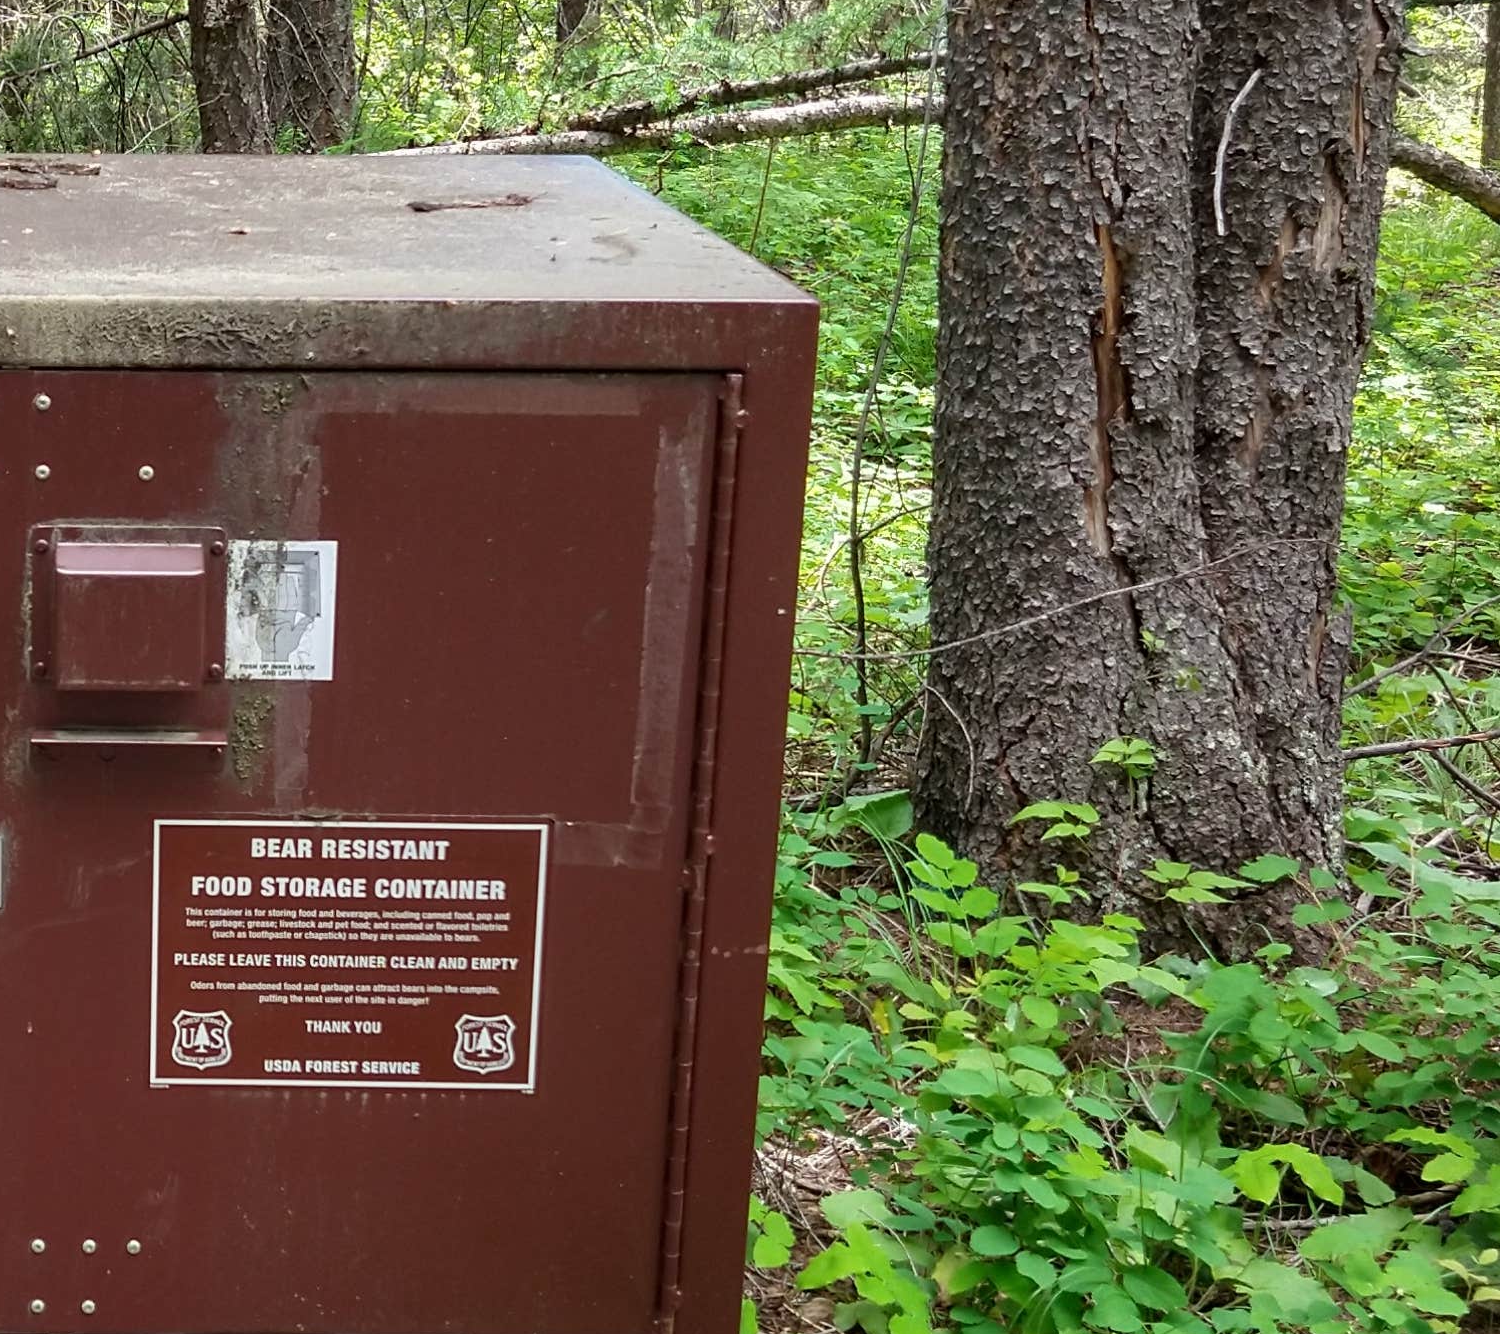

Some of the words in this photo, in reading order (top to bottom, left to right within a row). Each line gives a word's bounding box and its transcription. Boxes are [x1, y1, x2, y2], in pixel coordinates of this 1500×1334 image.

[251, 838, 312, 858] BEAR
[321, 840, 450, 860] RESISTANT
[192, 876, 252, 896] FOOD
[261, 877, 367, 898] STORAGE
[375, 879, 506, 900] CONTAINER
[186, 907, 201, 916] This
[204, 908, 241, 917] container
[245, 908, 251, 917] is
[253, 908, 265, 917] for
[268, 909, 296, 920] storing
[299, 909, 316, 918] food
[319, 909, 334, 918] and
[336, 910, 380, 920] beverages,
[382, 910, 421, 921] including
[422, 911, 452, 920] canned
[454, 911, 474, 921] food,
[477, 913, 492, 922] pop
[494, 912, 510, 921] and
[186, 918, 206, 928] beer;
[209, 919, 244, 929] garbage;
[247, 920, 277, 930] grease;
[280, 920, 315, 930] livestock
[318, 920, 333, 929] and
[335, 921, 349, 931] pet
[374, 921, 389, 931] and
[391, 921, 423, 931] scented
[425, 924, 435, 932] or
[436, 922, 469, 932] flavored
[213, 930, 234, 939] (such
[237, 931, 246, 939] as
[249, 930, 291, 941] toothpaste
[294, 932, 302, 940] or
[304, 930, 346, 941] chapstick)
[349, 933, 358, 941] so
[360, 932, 377, 943] they
[444, 933, 453, 942] to
[455, 933, 481, 943] bears.
[174, 953, 225, 965] PLEASE
[229, 954, 271, 966] LEAVE
[275, 954, 306, 966] THIS
[310, 955, 386, 968] CONTAINER
[390, 957, 435, 969] CLEAN
[438, 957, 468, 970] AND
[470, 958, 518, 971] EMPTY
[191, 982, 213, 990] Odors
[216, 982, 235, 990] from
[237, 982, 281, 991] abandoned
[284, 983, 301, 991] food
[304, 983, 318, 992] and
[321, 984, 353, 993] garbage
[356, 984, 371, 992] can
[373, 984, 399, 993] attract
[402, 984, 424, 993] bears
[427, 984, 442, 993] into
[445, 984, 458, 993] the
[259, 993, 288, 1004] putting
[290, 994, 303, 1003] the
[305, 994, 323, 1003] next
[325, 995, 343, 1003] user
[345, 994, 354, 1004] of
[356, 994, 368, 1004] the
[370, 995, 385, 1004] site
[388, 995, 396, 1004] in
[397, 995, 430, 1006] danger!
[305, 1020, 351, 1033] THANK
[354, 1021, 382, 1034] YOU
[264, 1060, 301, 1073] USDA
[306, 1060, 357, 1074] FOREST
[362, 1061, 420, 1074] SERVICE
